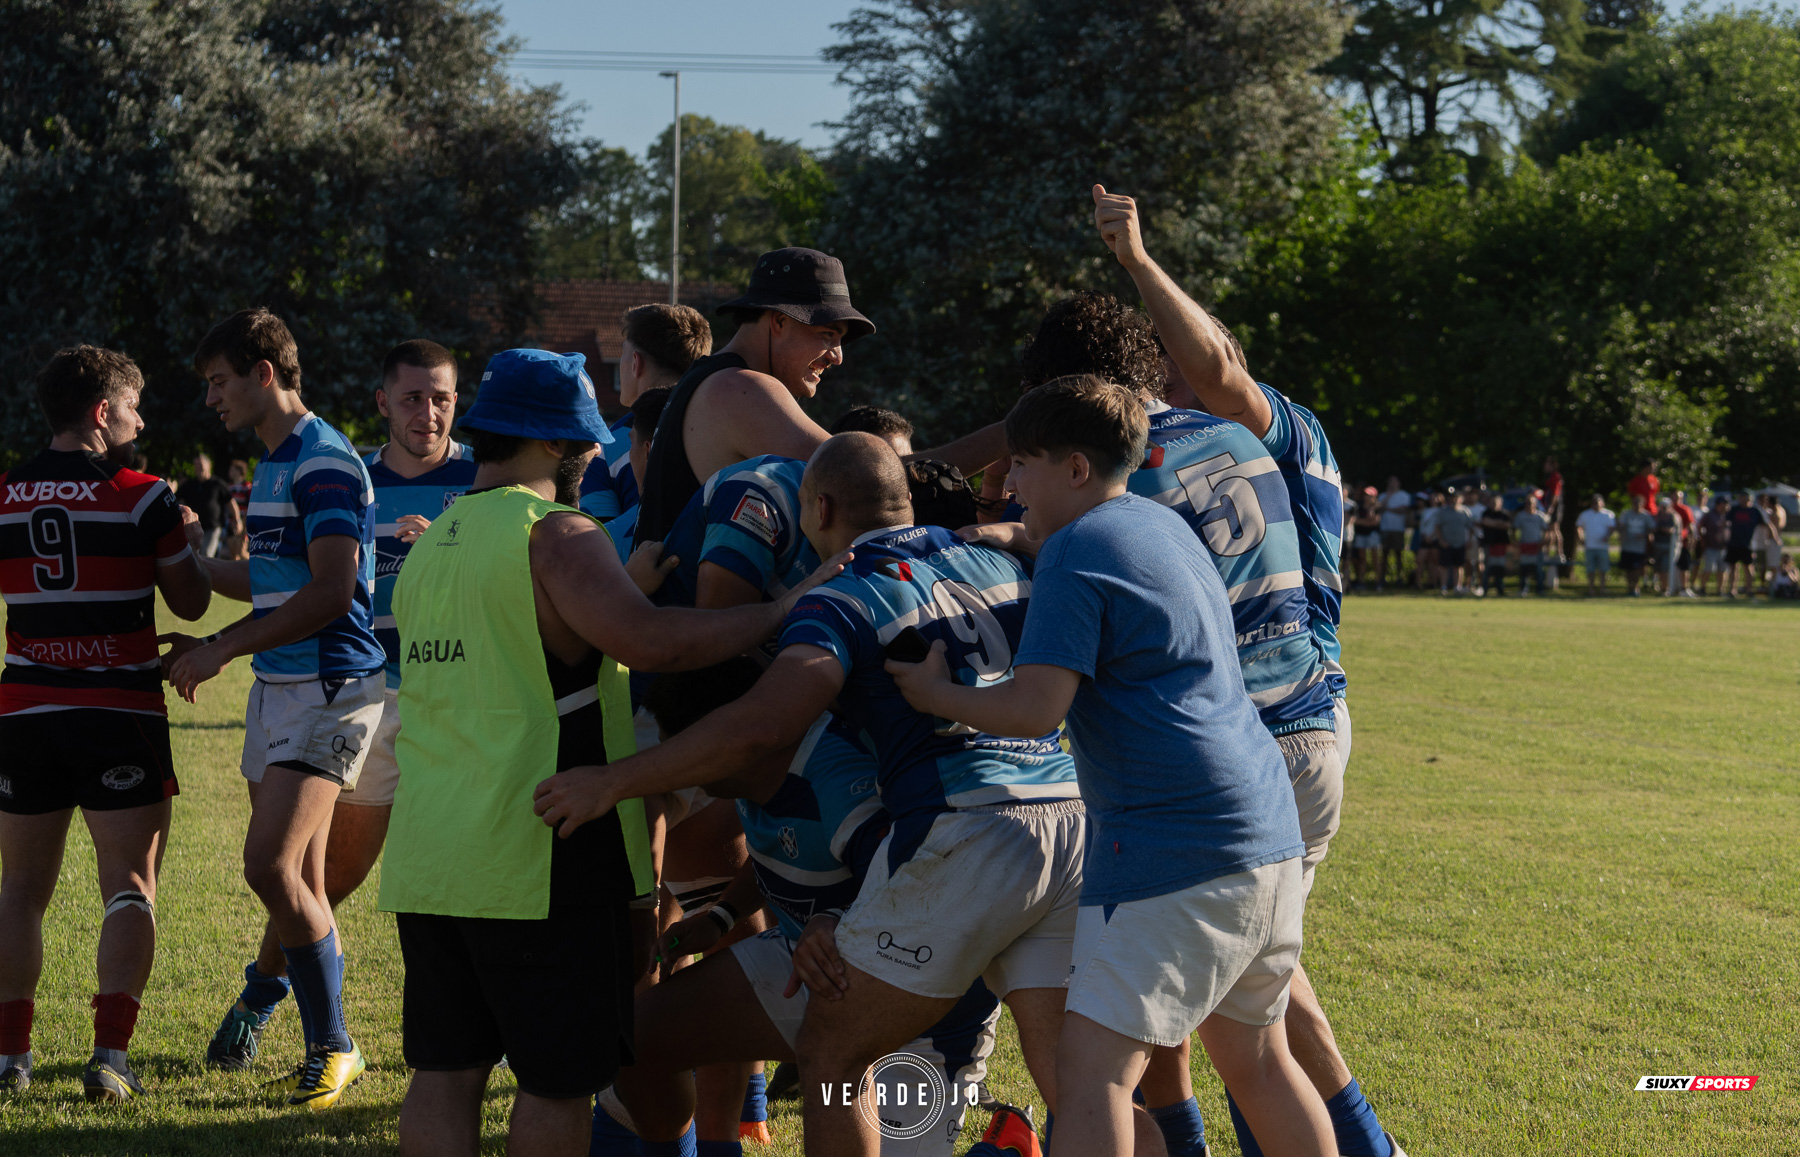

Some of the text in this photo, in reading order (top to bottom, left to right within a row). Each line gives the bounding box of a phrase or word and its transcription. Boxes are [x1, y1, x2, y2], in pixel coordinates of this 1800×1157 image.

[1166, 422, 1237, 450] AUTOSANZ
[4, 481, 101, 504] XUBOX
[1174, 450, 1267, 556] 5
[29, 504, 79, 594] 9
[884, 527, 928, 549] WALKER
[931, 577, 1013, 682] 9
[406, 639, 466, 664] AGUA
[876, 950, 922, 971] PURA SANGRE
